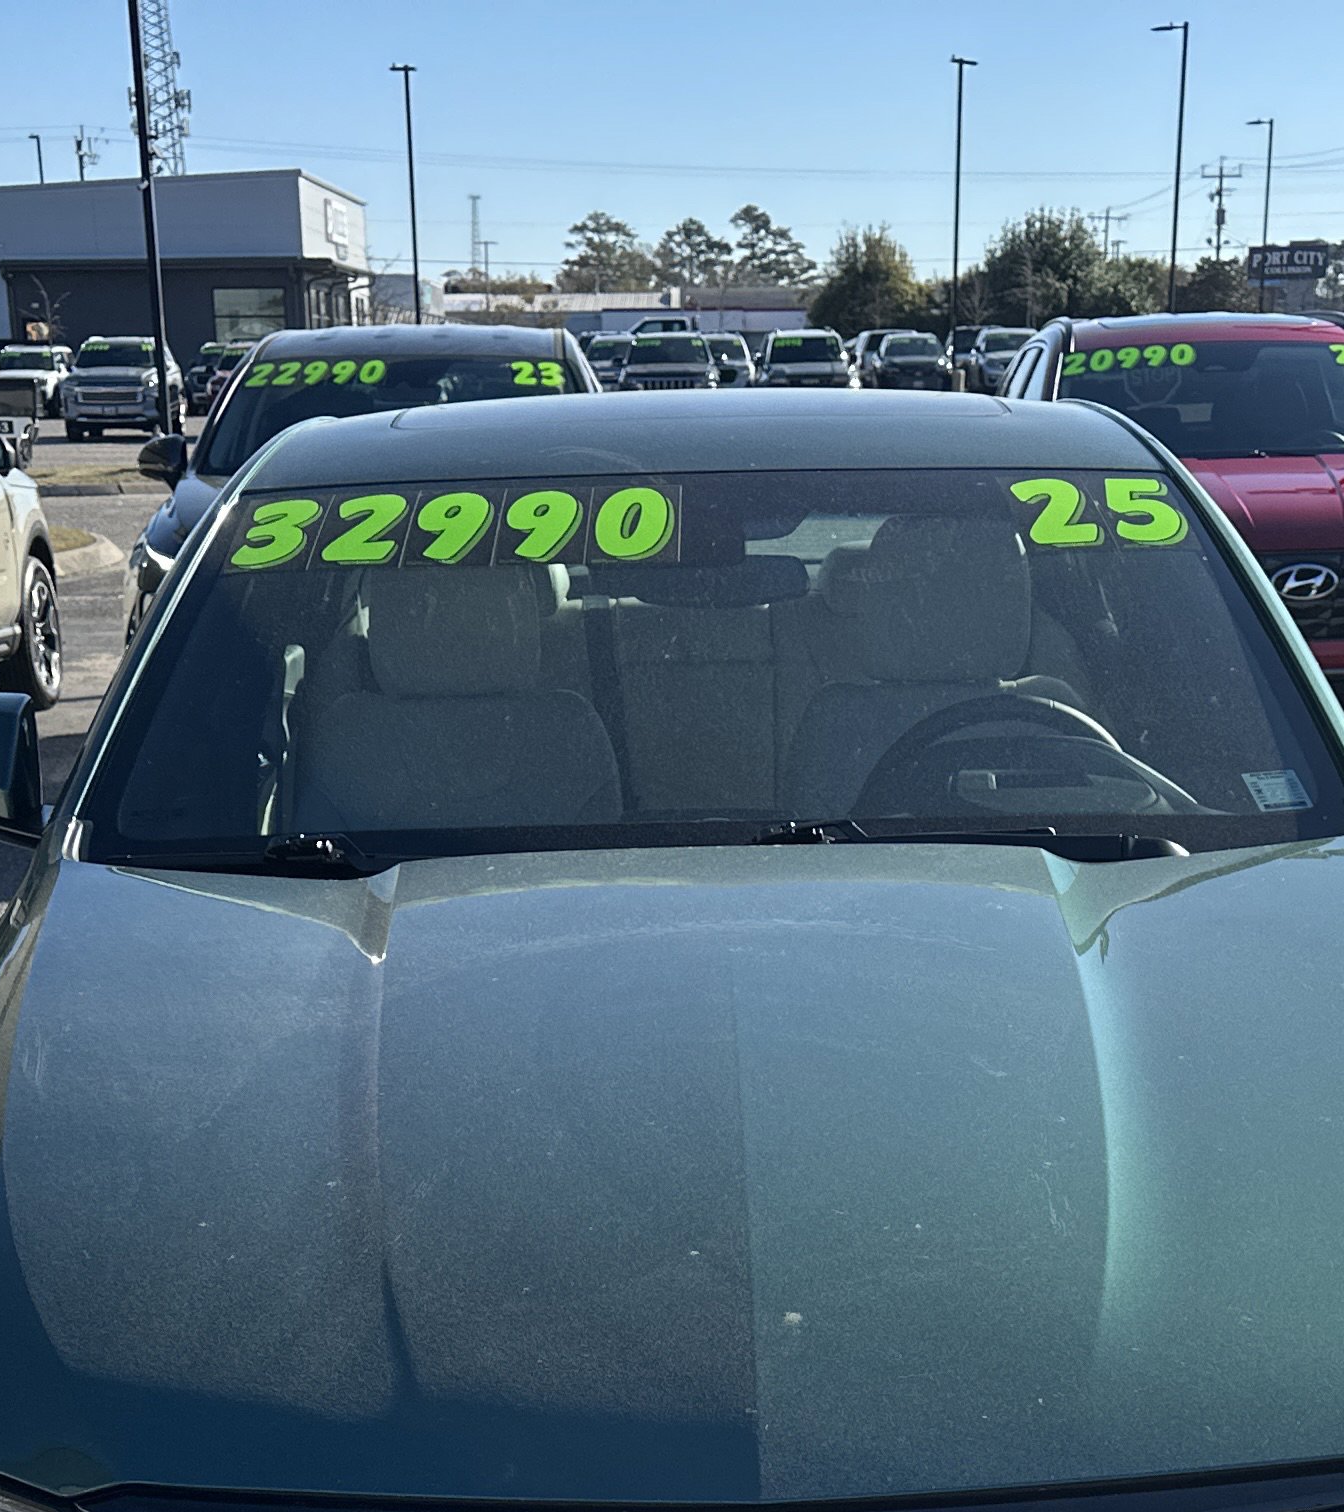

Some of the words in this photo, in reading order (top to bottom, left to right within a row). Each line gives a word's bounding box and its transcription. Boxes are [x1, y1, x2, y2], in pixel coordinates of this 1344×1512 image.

[1294, 250, 1326, 266] CITY
[245, 360, 386, 388] 22990
[511, 360, 565, 388] 23
[1063, 343, 1196, 376] 20990
[230, 487, 674, 570] 32990
[1010, 478, 1189, 548] 25
